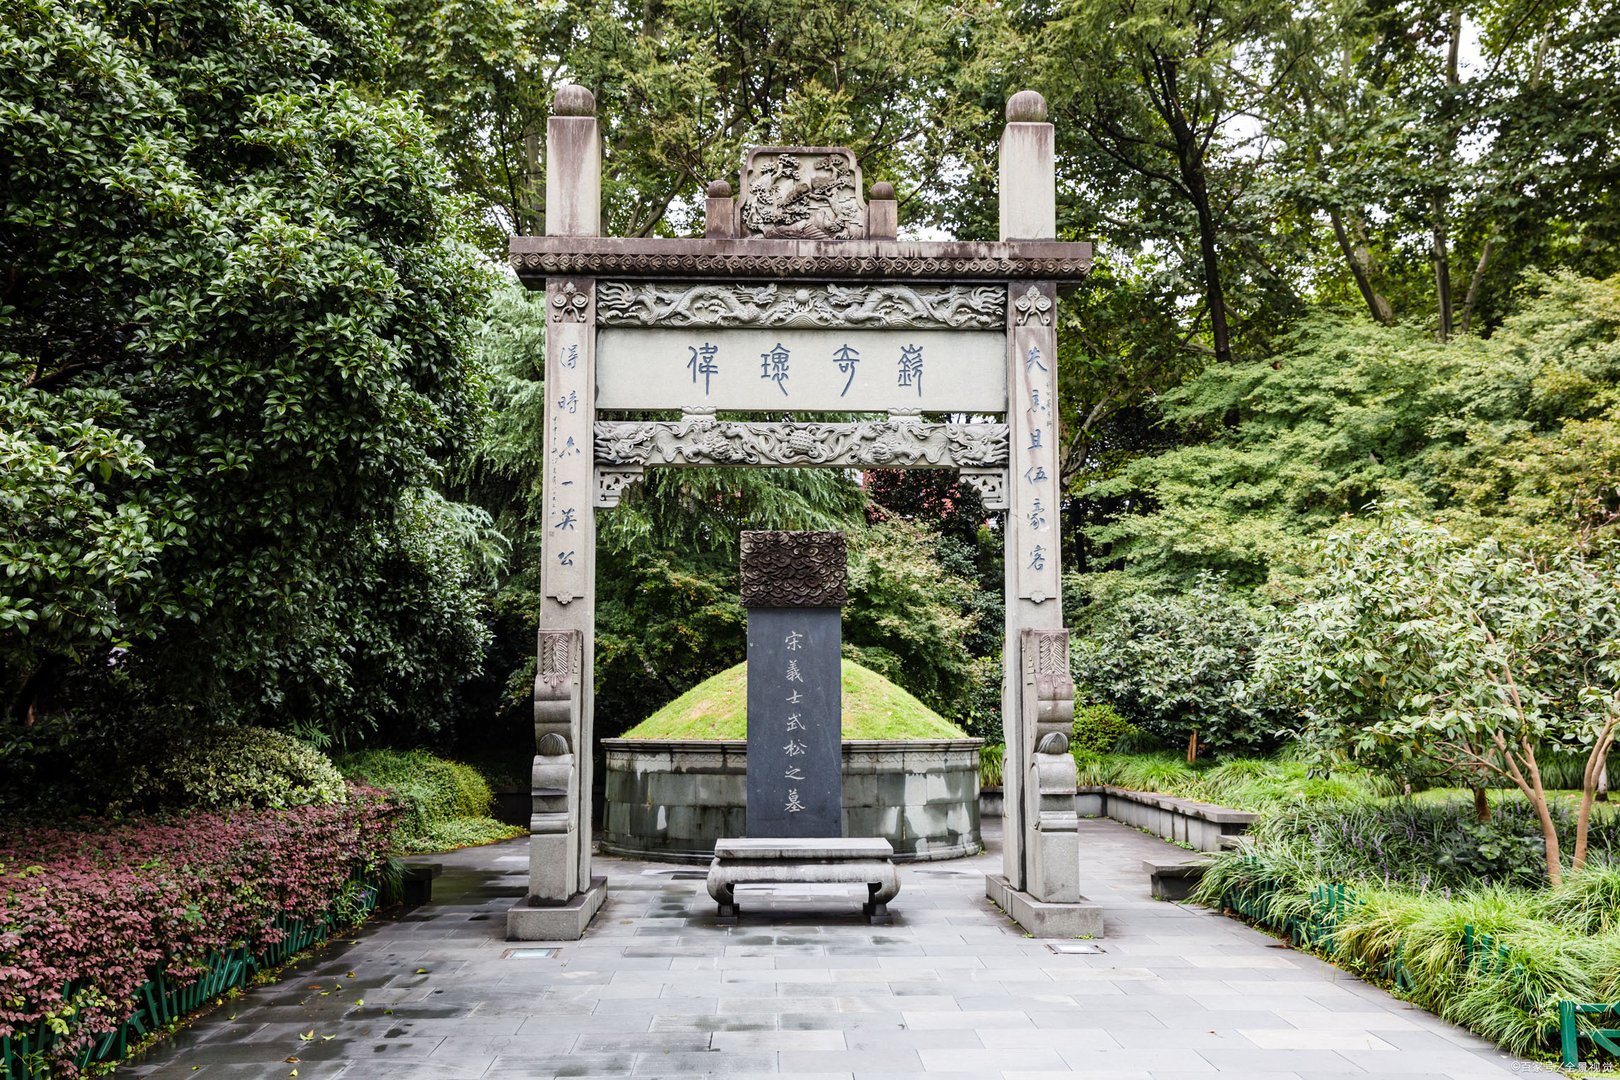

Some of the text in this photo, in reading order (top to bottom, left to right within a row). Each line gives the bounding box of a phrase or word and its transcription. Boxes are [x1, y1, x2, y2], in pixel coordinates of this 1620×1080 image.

[782, 630, 808, 813] 宋義士武松之墓
